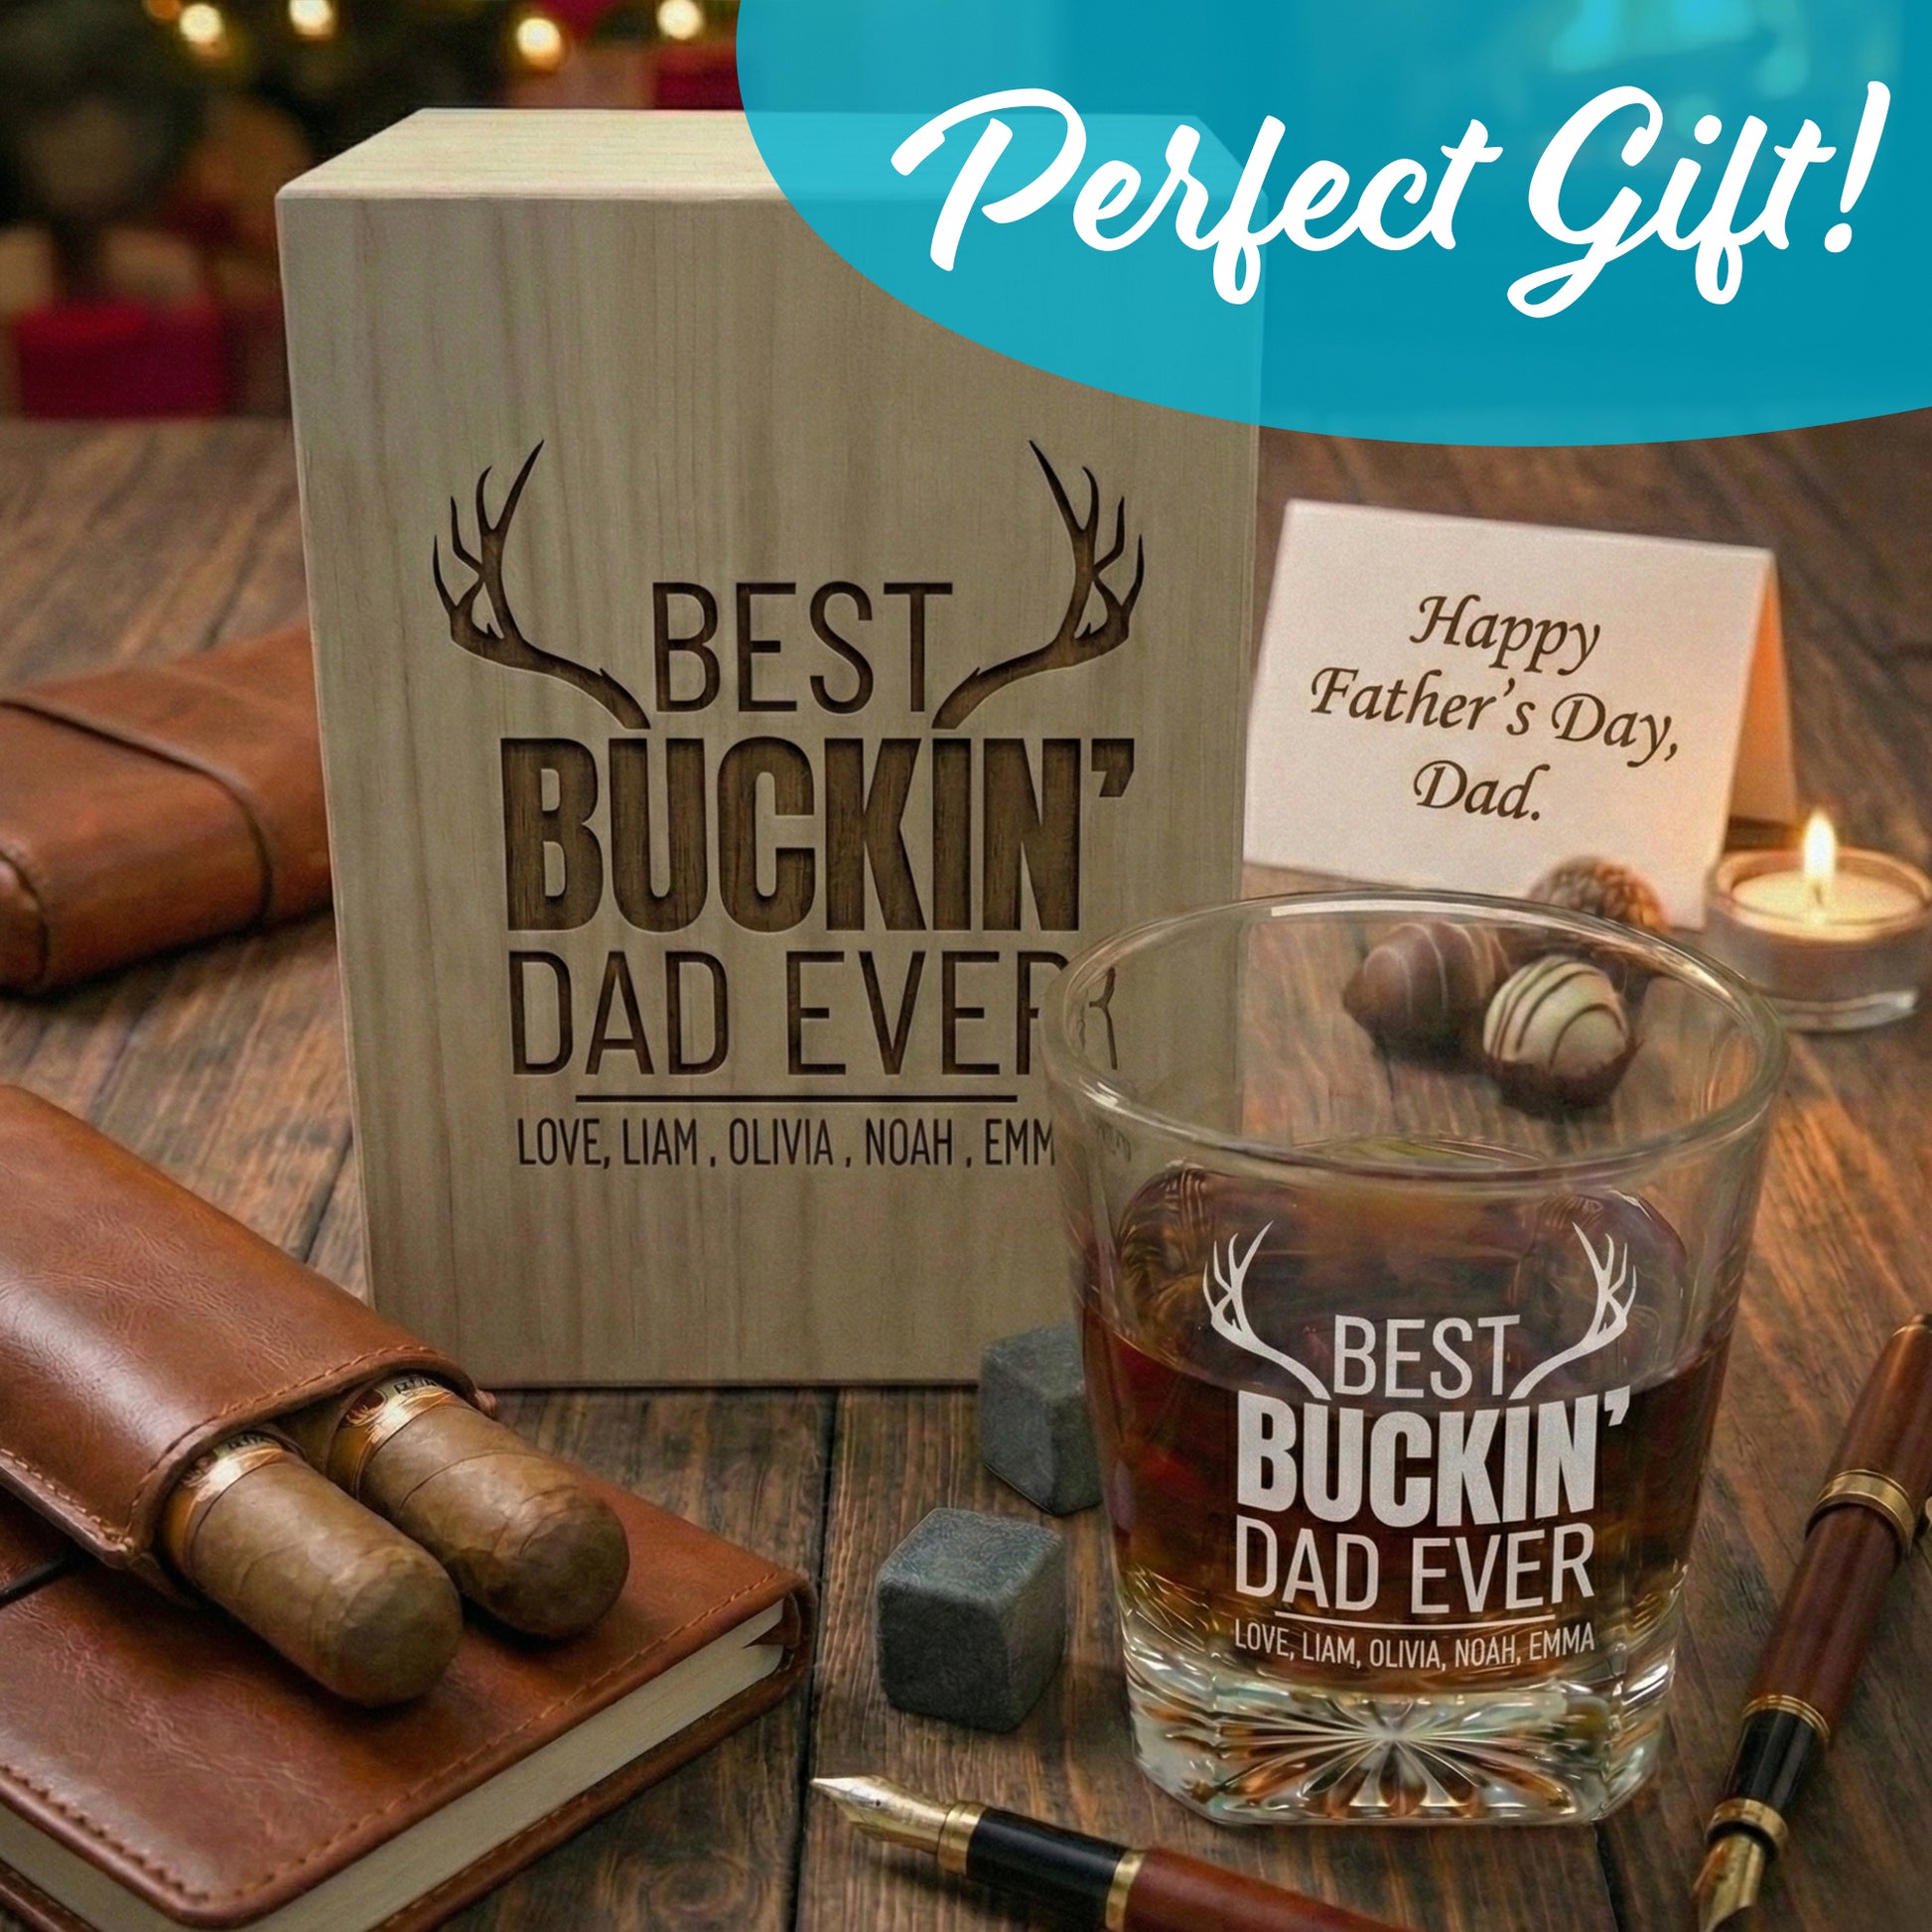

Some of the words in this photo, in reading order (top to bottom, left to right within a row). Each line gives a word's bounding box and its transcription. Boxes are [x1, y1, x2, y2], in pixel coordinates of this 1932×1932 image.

[652, 580, 953, 714] BEST
[1409, 594, 1601, 676] Happy
[1311, 666, 1536, 736] Father's
[1551, 692, 1679, 768] Day,
[499, 736, 1135, 932] BUCKIN'
[1413, 759, 1551, 821] Dad.
[507, 950, 730, 1075] DAD
[517, 1118, 611, 1170] LOVE,
[985, 1118, 1055, 1167] EMM
[1333, 1313, 1521, 1400] BEST
[1236, 1385, 1630, 1528] BUCKIN'
[1235, 1514, 1380, 1611] DAD
[1411, 1522, 1594, 1615] EVER
[1235, 1618, 1296, 1661] LOVE,
[1303, 1631, 1362, 1670] LIAM,
[1369, 1638, 1447, 1672] OLIVIA,
[1454, 1635, 1522, 1669] NOAH,
[1529, 1621, 1595, 1661] EMMA
